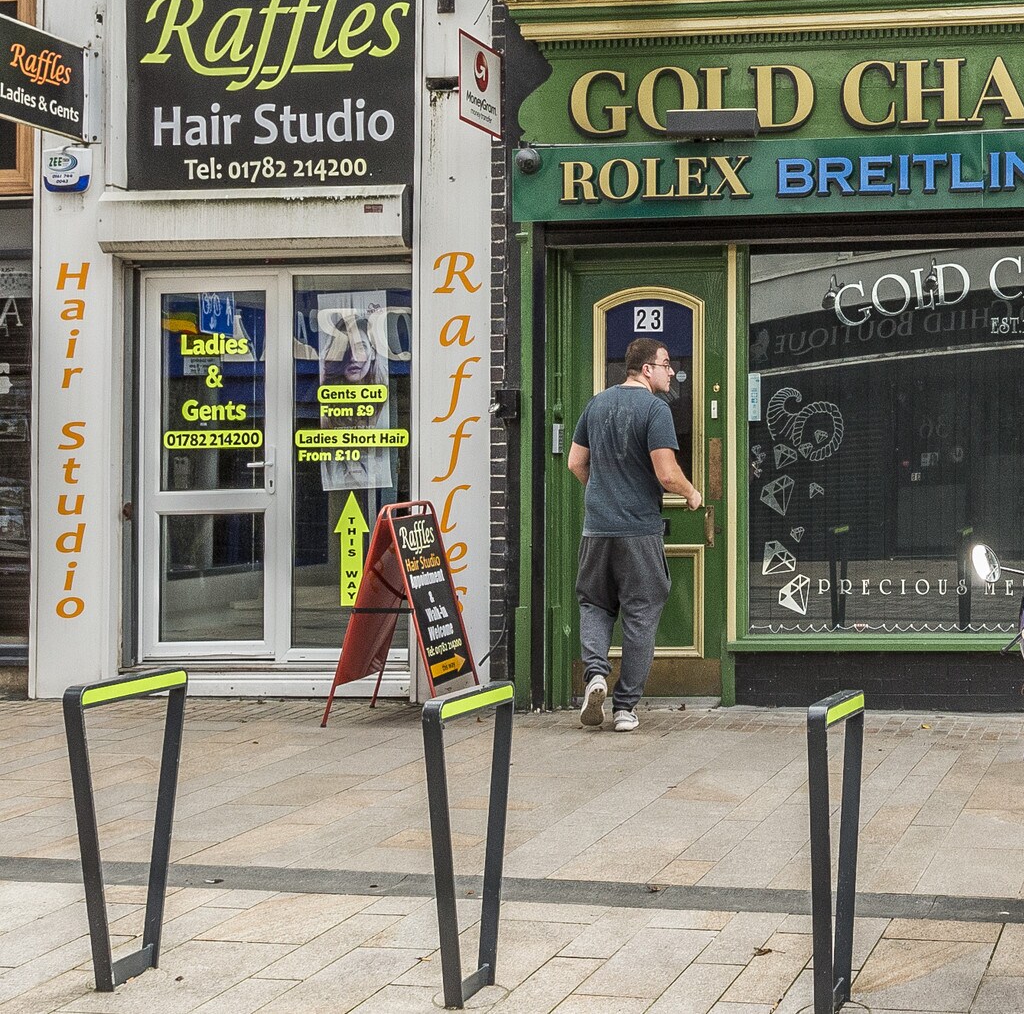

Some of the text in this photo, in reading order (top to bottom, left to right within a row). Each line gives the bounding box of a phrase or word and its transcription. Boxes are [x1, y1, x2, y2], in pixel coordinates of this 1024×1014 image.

[9, 43, 72, 87] Raffles
[0, 82, 80, 123] Ladies & Gents
[153, 98, 395, 147] Hair Studio
[49, 157, 63, 167] ZEE
[184, 157, 367, 183] Tel: 01782 214200
[559, 155, 751, 203] ROLEX
[834, 263, 970, 326] GOLD
[55, 262, 90, 389] Hair
[636, 308, 661, 330] 23
[180, 332, 249, 356] Ladies
[205, 364, 224, 388] &
[321, 388, 383, 399] Gents Cut
[181, 399, 247, 422] Gents
[320, 404, 375, 417] From £9
[167, 432, 259, 447] 01782 214200
[299, 432, 406, 444] Ladies Short Hair
[298, 449, 361, 461] From £10
[55, 421, 88, 619] Studio
[347, 517, 357, 557] THIS
[399, 519, 435, 555] Raffles
[405, 553, 441, 573] Hair Studio
[346, 571, 358, 600] WAY
[409, 568, 446, 590] Appointment
[818, 578, 968, 595] PRECIOUS
[428, 590, 435, 603] &
